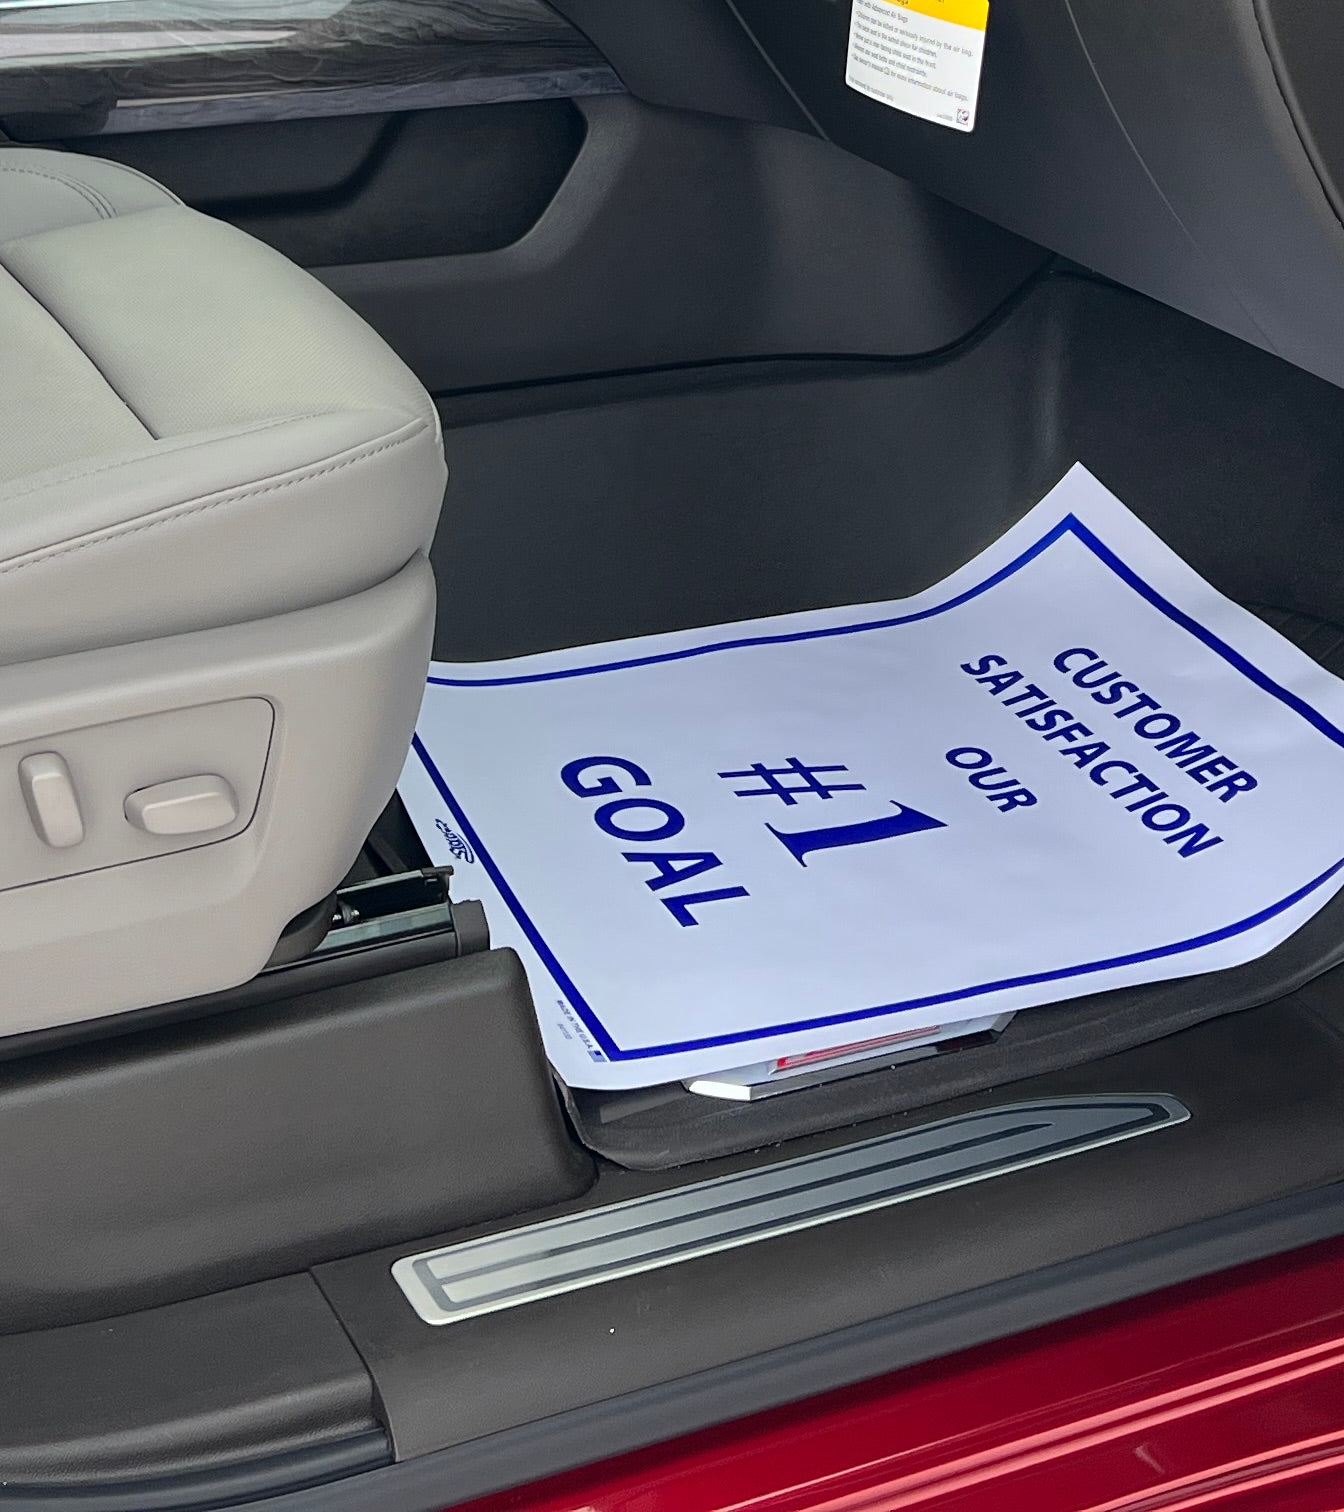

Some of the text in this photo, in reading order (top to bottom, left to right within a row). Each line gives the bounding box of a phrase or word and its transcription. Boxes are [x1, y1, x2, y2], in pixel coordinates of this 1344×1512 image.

[945, 746, 1039, 814] OUR
[960, 654, 1224, 859] SATISFACTION
[1054, 647, 1260, 804] CUSTOMER
[560, 755, 751, 928] GOAL
[717, 756, 949, 868] #1
